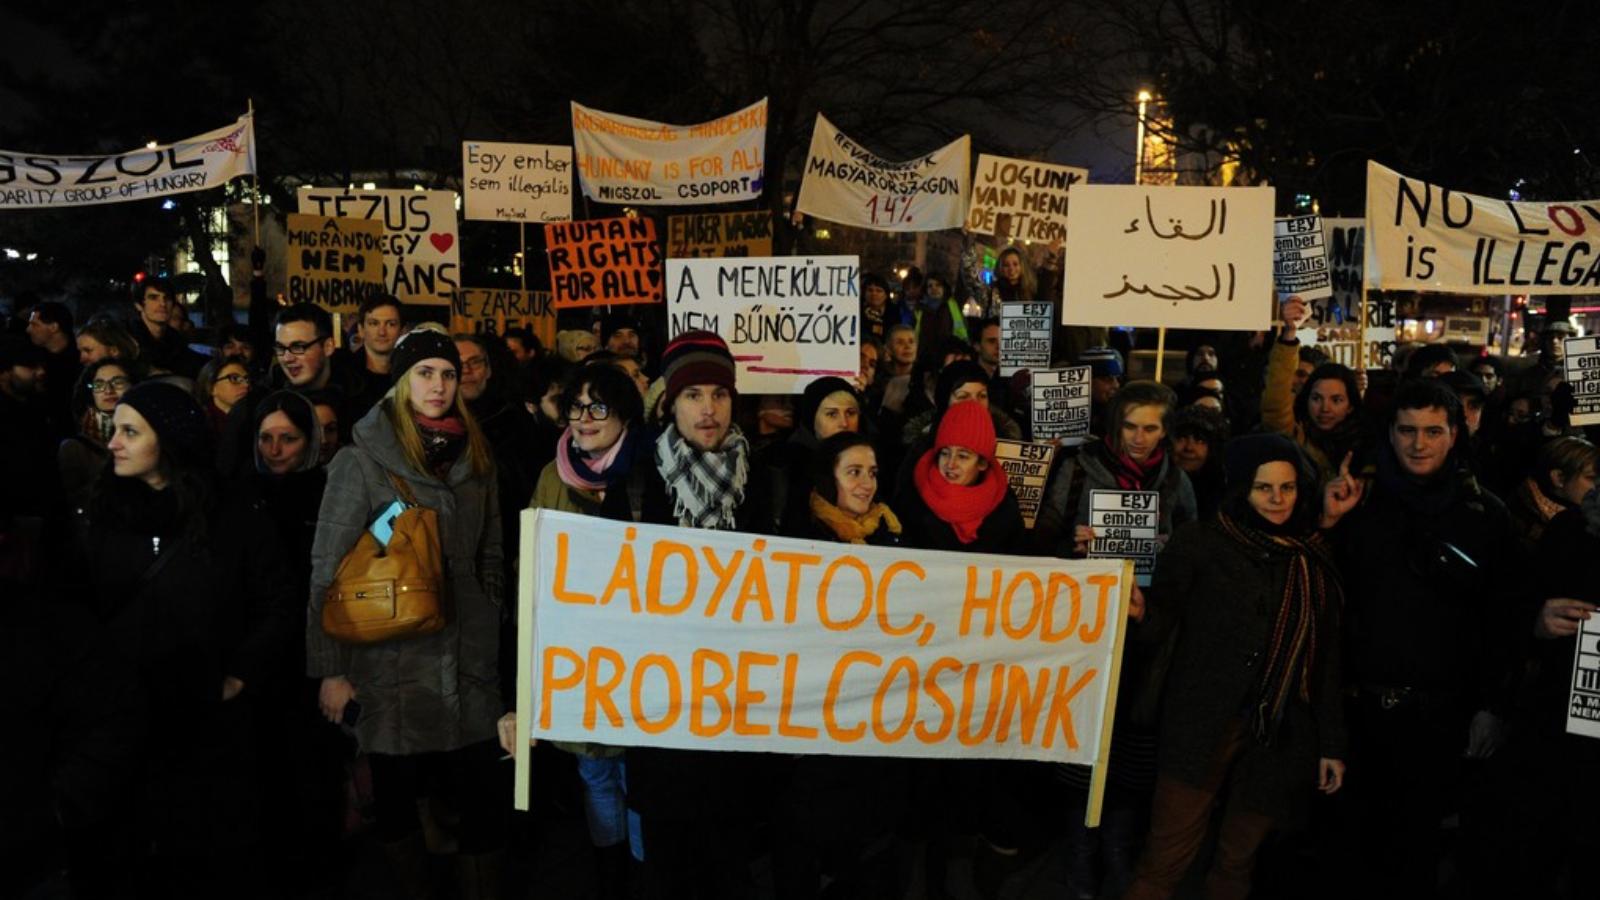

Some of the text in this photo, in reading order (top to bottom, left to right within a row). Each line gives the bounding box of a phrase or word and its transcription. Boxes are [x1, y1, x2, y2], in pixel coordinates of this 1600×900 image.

[468, 145, 570, 173] Egy ember
[576, 148, 762, 181] HUNGARY IS FOR ALL
[64, 187, 112, 202] GROUP
[119, 181, 139, 197] OF
[145, 172, 208, 193] HUNGARY
[470, 175, 569, 199] sem illegális
[599, 177, 750, 200] MIGSZOL CSOPORT
[976, 186, 1016, 207] VAN
[1395, 177, 1473, 228] NO
[324, 219, 339, 231] A
[553, 218, 647, 244] HUMAN
[1287, 216, 1317, 233] Egy
[1276, 234, 1316, 250] ember
[302, 249, 365, 273] NEM
[552, 241, 662, 271] RIGHTS
[1405, 235, 1437, 279] is
[555, 266, 661, 302] FOR ALL!
[676, 259, 860, 303] A MENEKÜLTEK
[1023, 304, 1048, 316] Egy
[672, 304, 857, 345] NEM BŰNÖZŐK!
[1009, 317, 1045, 330] ember
[1058, 369, 1086, 383] Egy
[1042, 385, 1083, 399] ember
[1019, 445, 1049, 461] Egy
[1003, 459, 1042, 475] ember
[1120, 493, 1152, 509] Egy
[1103, 512, 1149, 527] ember
[1104, 528, 1131, 539] sem
[552, 527, 1119, 647] LÁDYÁTOC, HODJ
[539, 646, 1098, 751] PROBELCOSUNK
